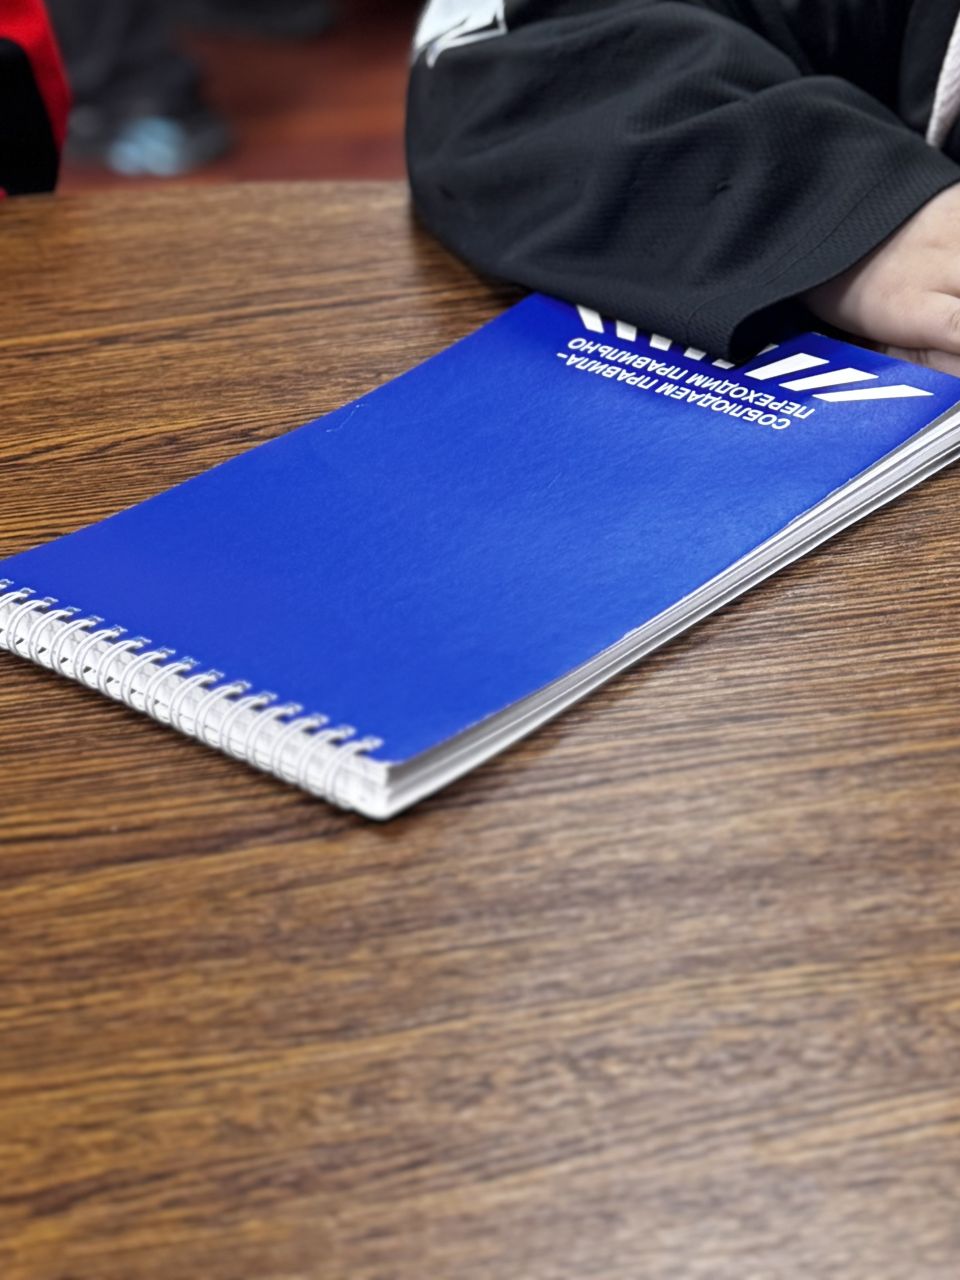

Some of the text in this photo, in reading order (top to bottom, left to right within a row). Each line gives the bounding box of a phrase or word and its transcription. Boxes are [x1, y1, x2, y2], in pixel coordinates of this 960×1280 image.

[567, 337, 815, 419] ПЕРЕХОДИМ ПРАВИЛЬНО
[655, 383, 791, 430] СОБЛЮДАЕМ
